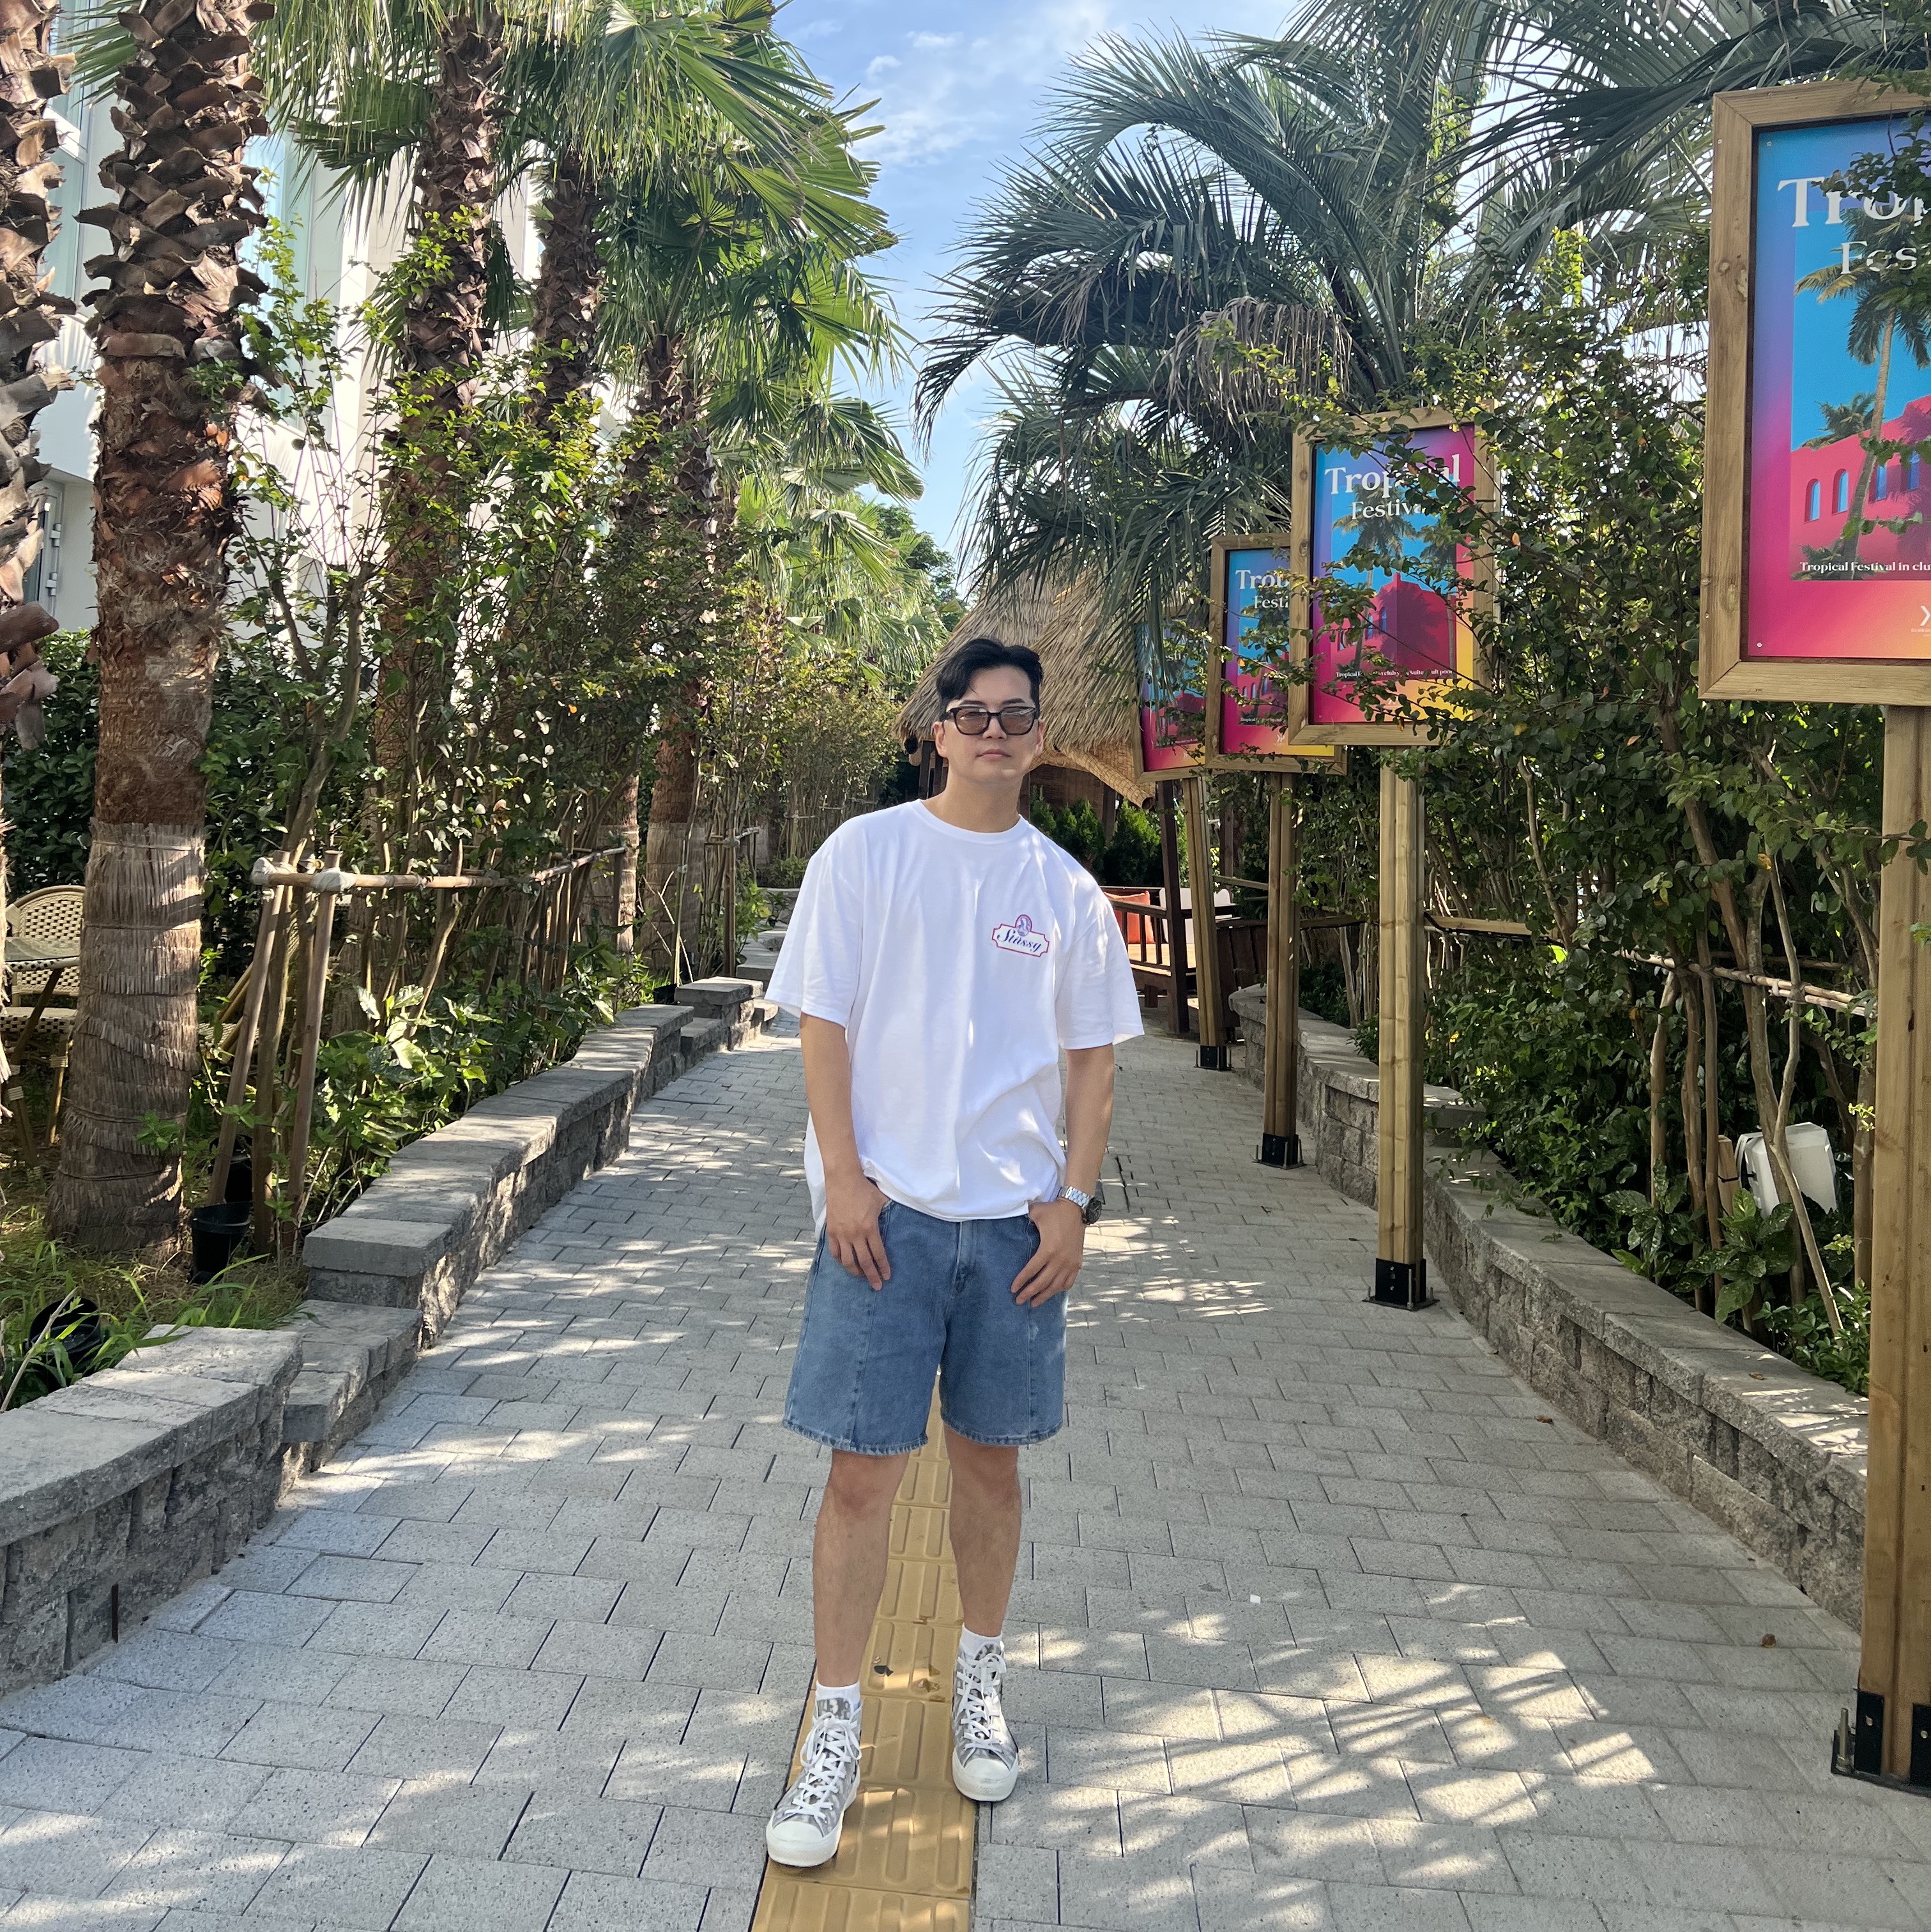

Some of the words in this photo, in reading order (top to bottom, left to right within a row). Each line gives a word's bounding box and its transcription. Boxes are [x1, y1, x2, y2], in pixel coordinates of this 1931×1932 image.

[1799, 562, 1848, 574] Tropical
[1851, 562, 1895, 571] Festival
[1898, 562, 1910, 571] in
